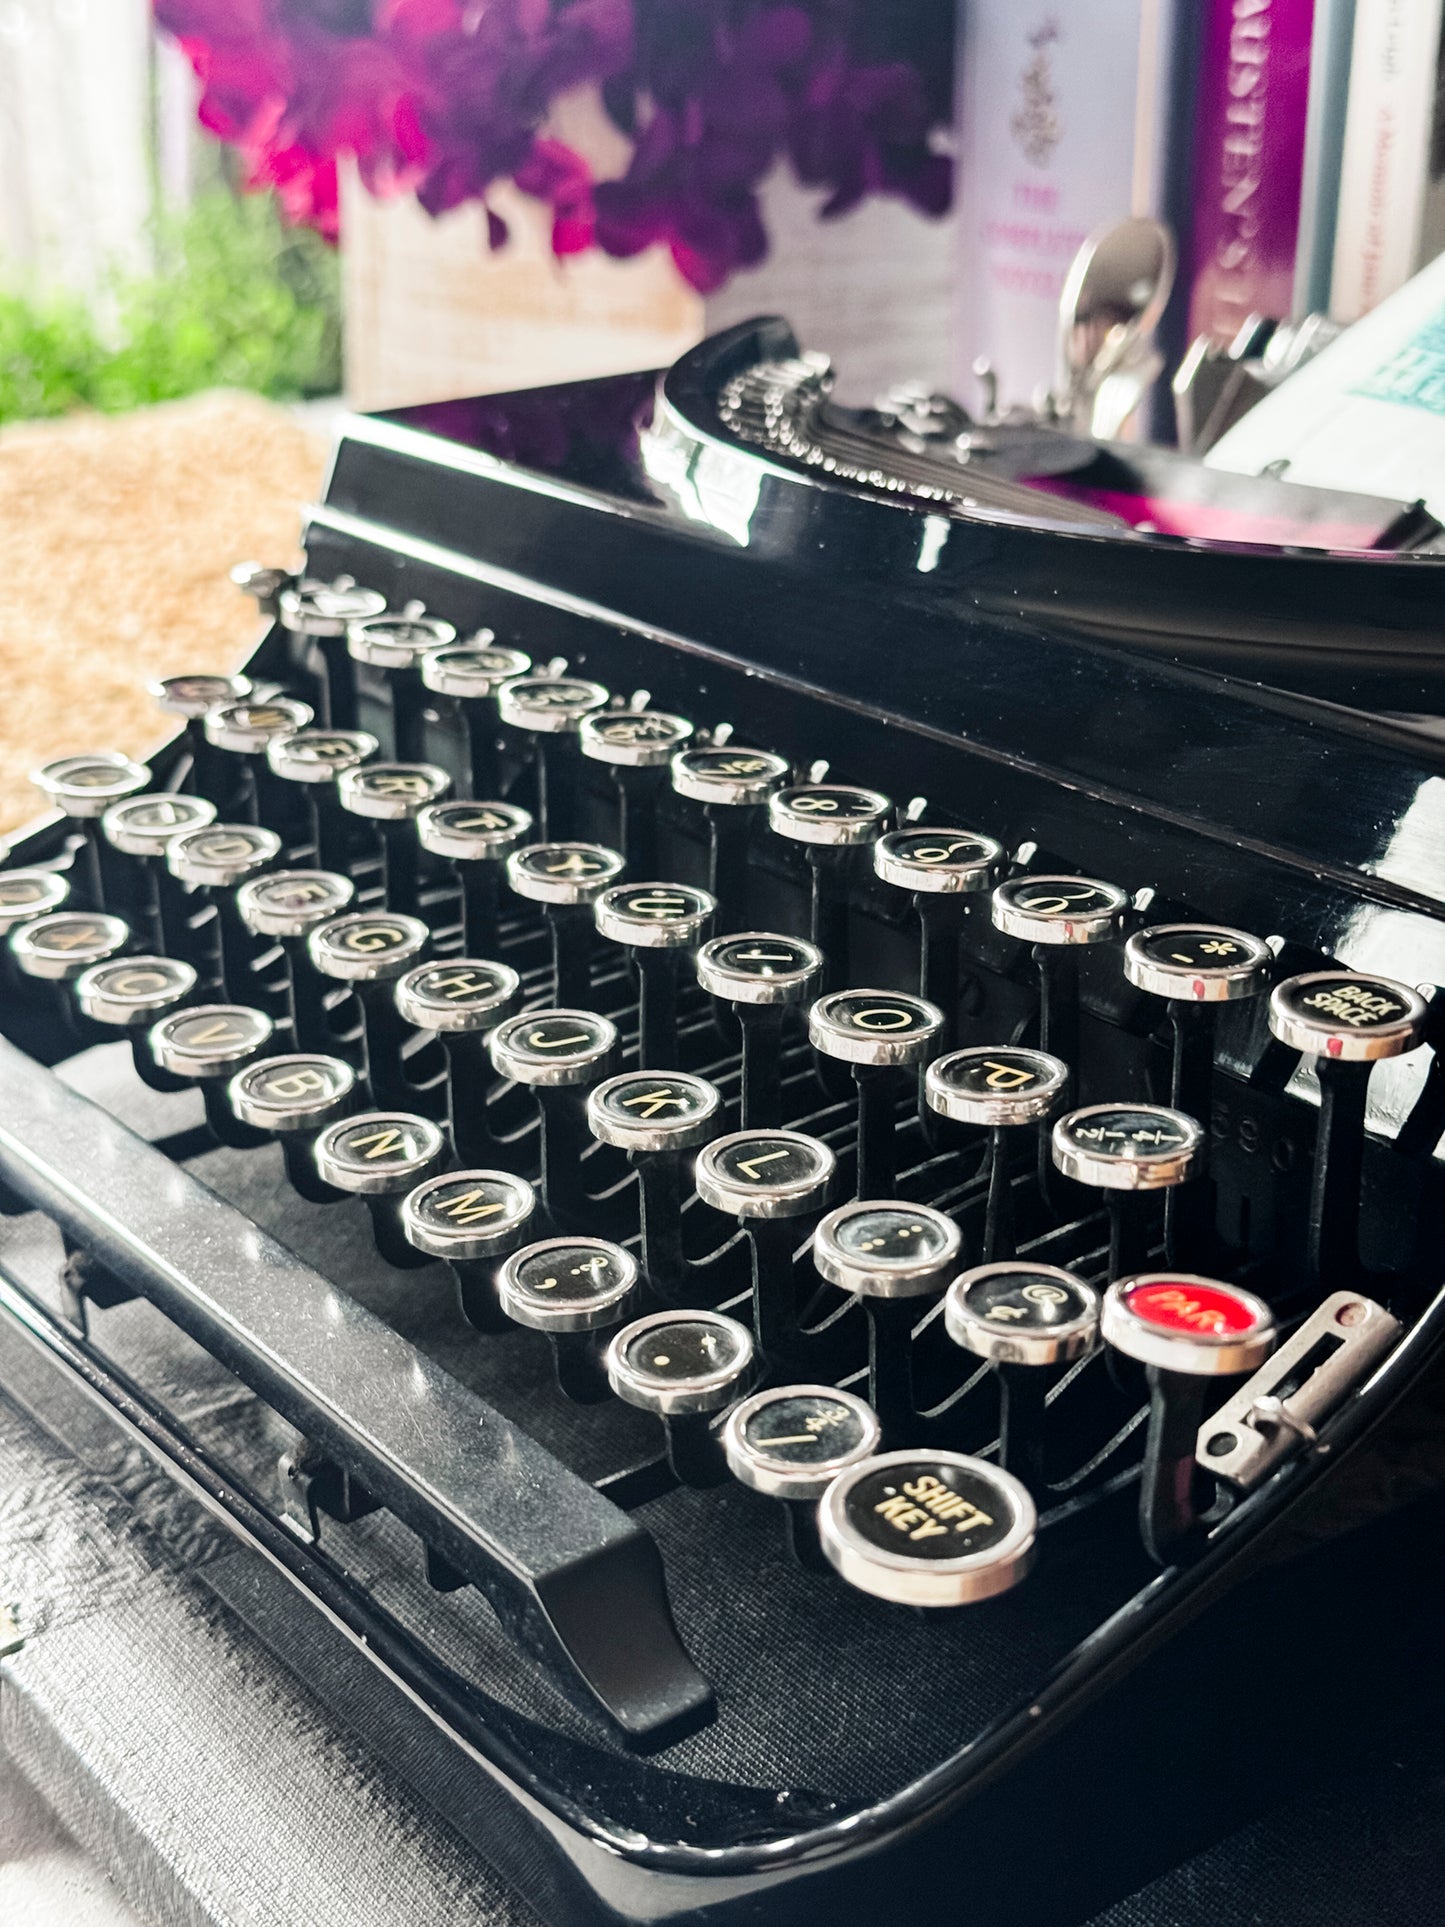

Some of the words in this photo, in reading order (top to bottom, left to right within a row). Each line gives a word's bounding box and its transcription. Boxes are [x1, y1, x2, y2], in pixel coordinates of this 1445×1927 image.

[375, 774, 430, 797] R
[790, 797, 839, 811] 8
[454, 812, 509, 828] T
[546, 854, 602, 872] Y
[913, 848, 950, 863] 9
[272, 883, 330, 900] F
[628, 897, 685, 915] U
[50, 927, 103, 950] X
[346, 927, 403, 951] G
[115, 972, 168, 994] C
[430, 972, 492, 998] H
[1304, 991, 1378, 1028] SPACE
[1333, 985, 1402, 1017] BACK
[188, 1021, 244, 1045] V
[528, 1032, 589, 1049] J
[266, 1068, 325, 1099] B
[983, 1061, 1035, 1088] P
[622, 1089, 690, 1119] K
[350, 1128, 411, 1159] N
[737, 1150, 790, 1180] L
[435, 1189, 504, 1225] M
[902, 1474, 995, 1533] SHIFT
[873, 1494, 949, 1542] KEY
